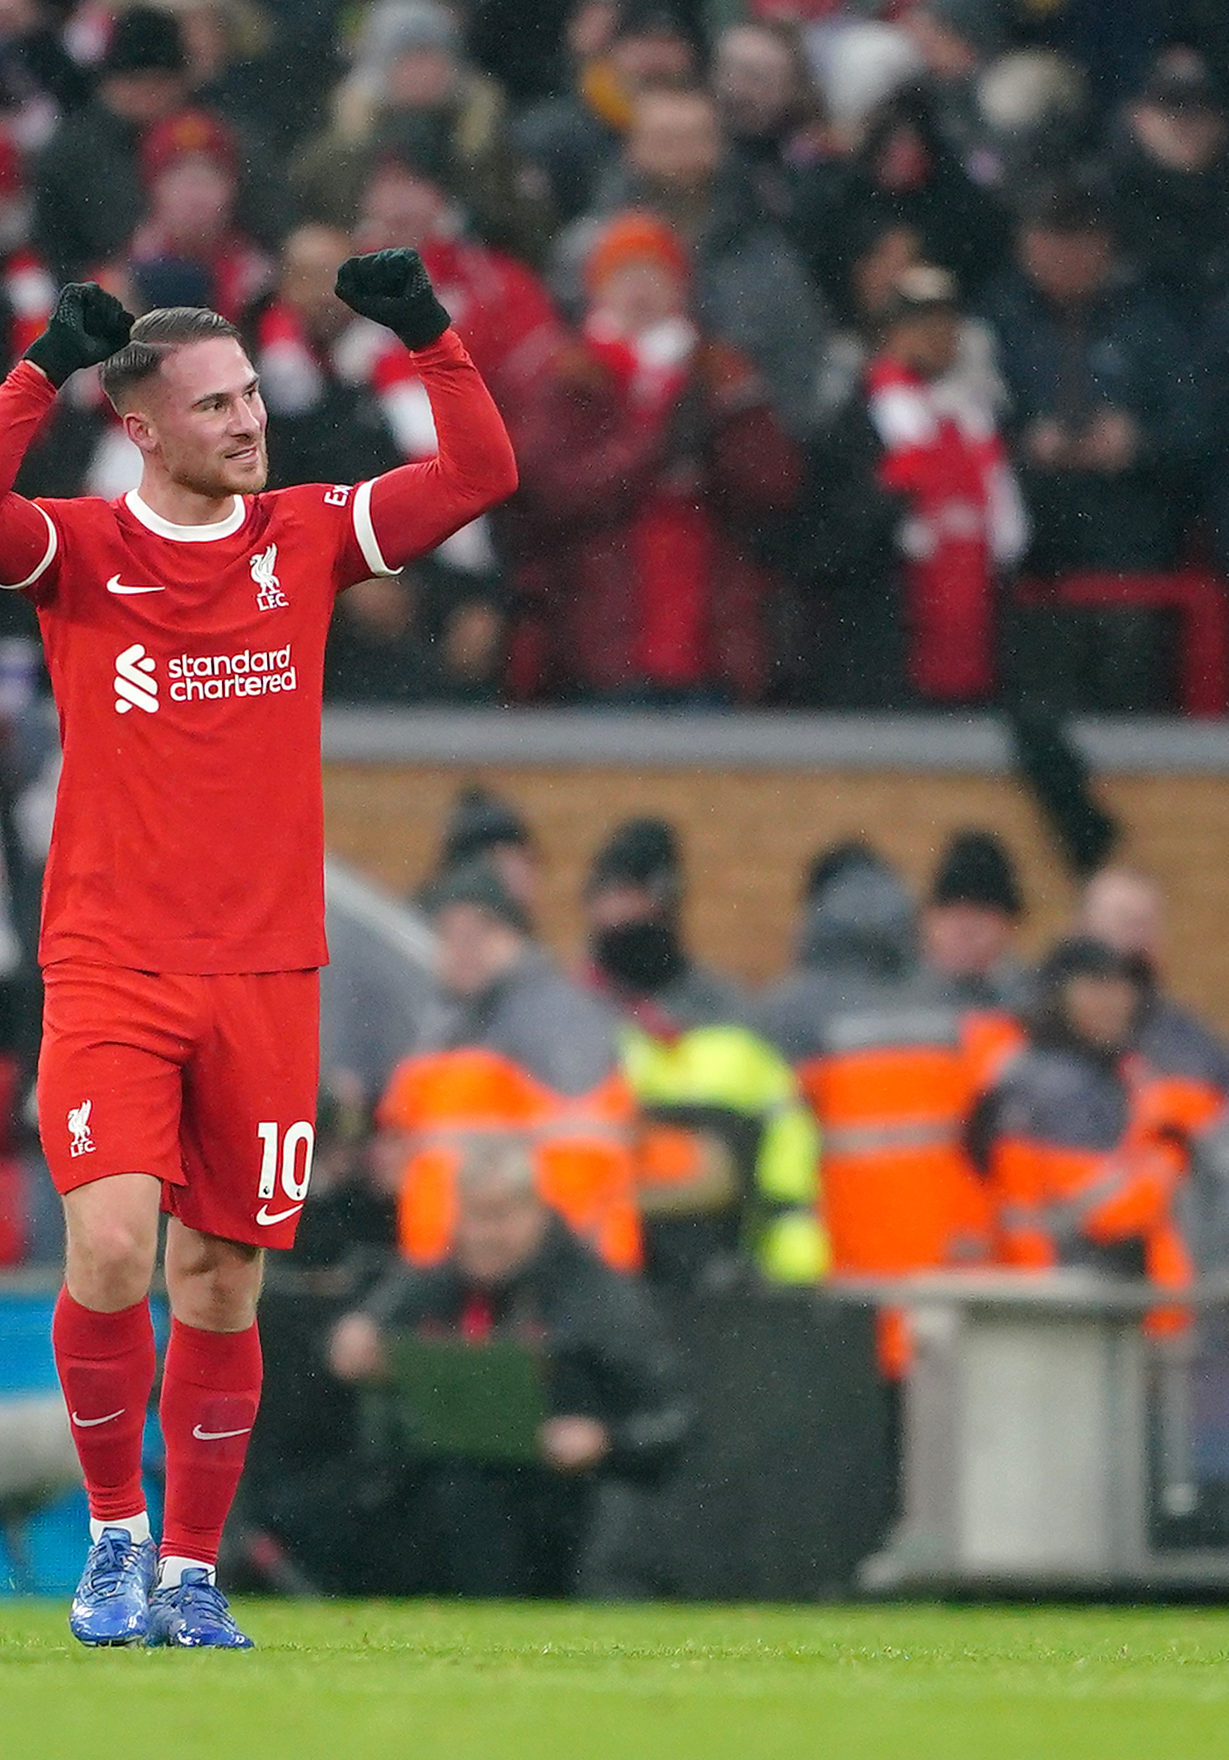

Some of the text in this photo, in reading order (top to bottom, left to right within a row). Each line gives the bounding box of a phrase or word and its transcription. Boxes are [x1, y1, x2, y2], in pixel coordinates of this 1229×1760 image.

[168, 644, 291, 678] standard
[170, 666, 297, 701] chartered
[257, 1121, 315, 1201] 10
